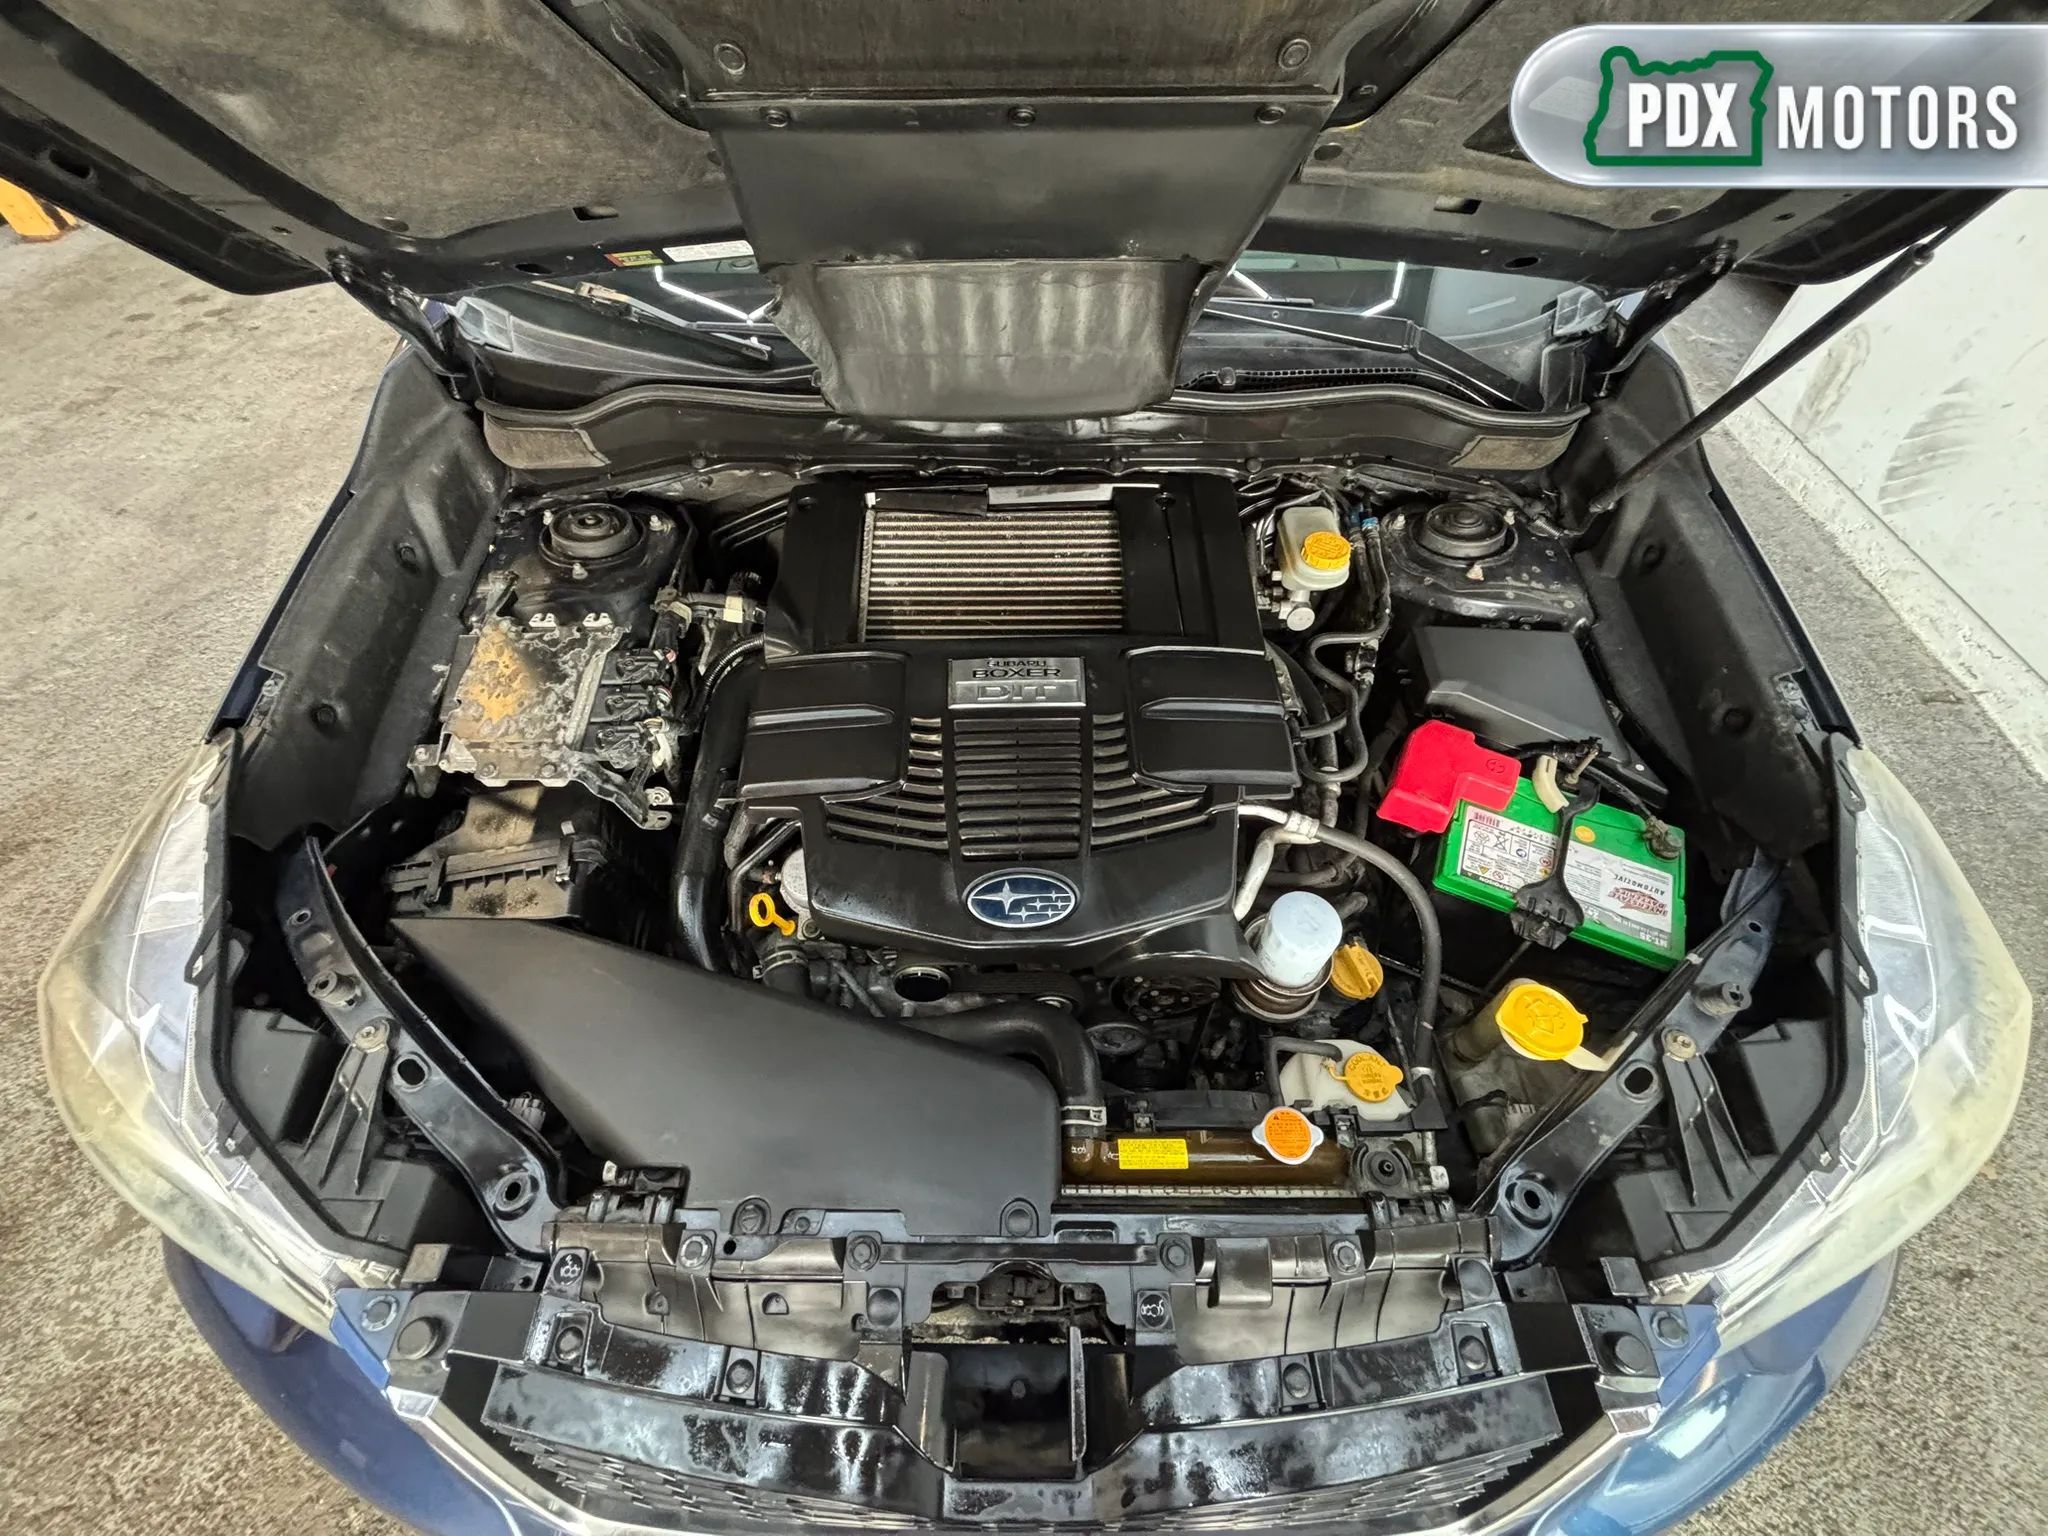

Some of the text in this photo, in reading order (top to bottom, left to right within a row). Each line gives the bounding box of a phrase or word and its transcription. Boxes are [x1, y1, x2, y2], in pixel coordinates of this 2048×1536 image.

[973, 668, 1061, 678] BOXER
[977, 685, 1057, 700] DIT
[1613, 874, 1664, 894] AUTOMOTIVE
[1607, 891, 1667, 916] INTERSTATE
[1613, 887, 1665, 909] BATTERIES
